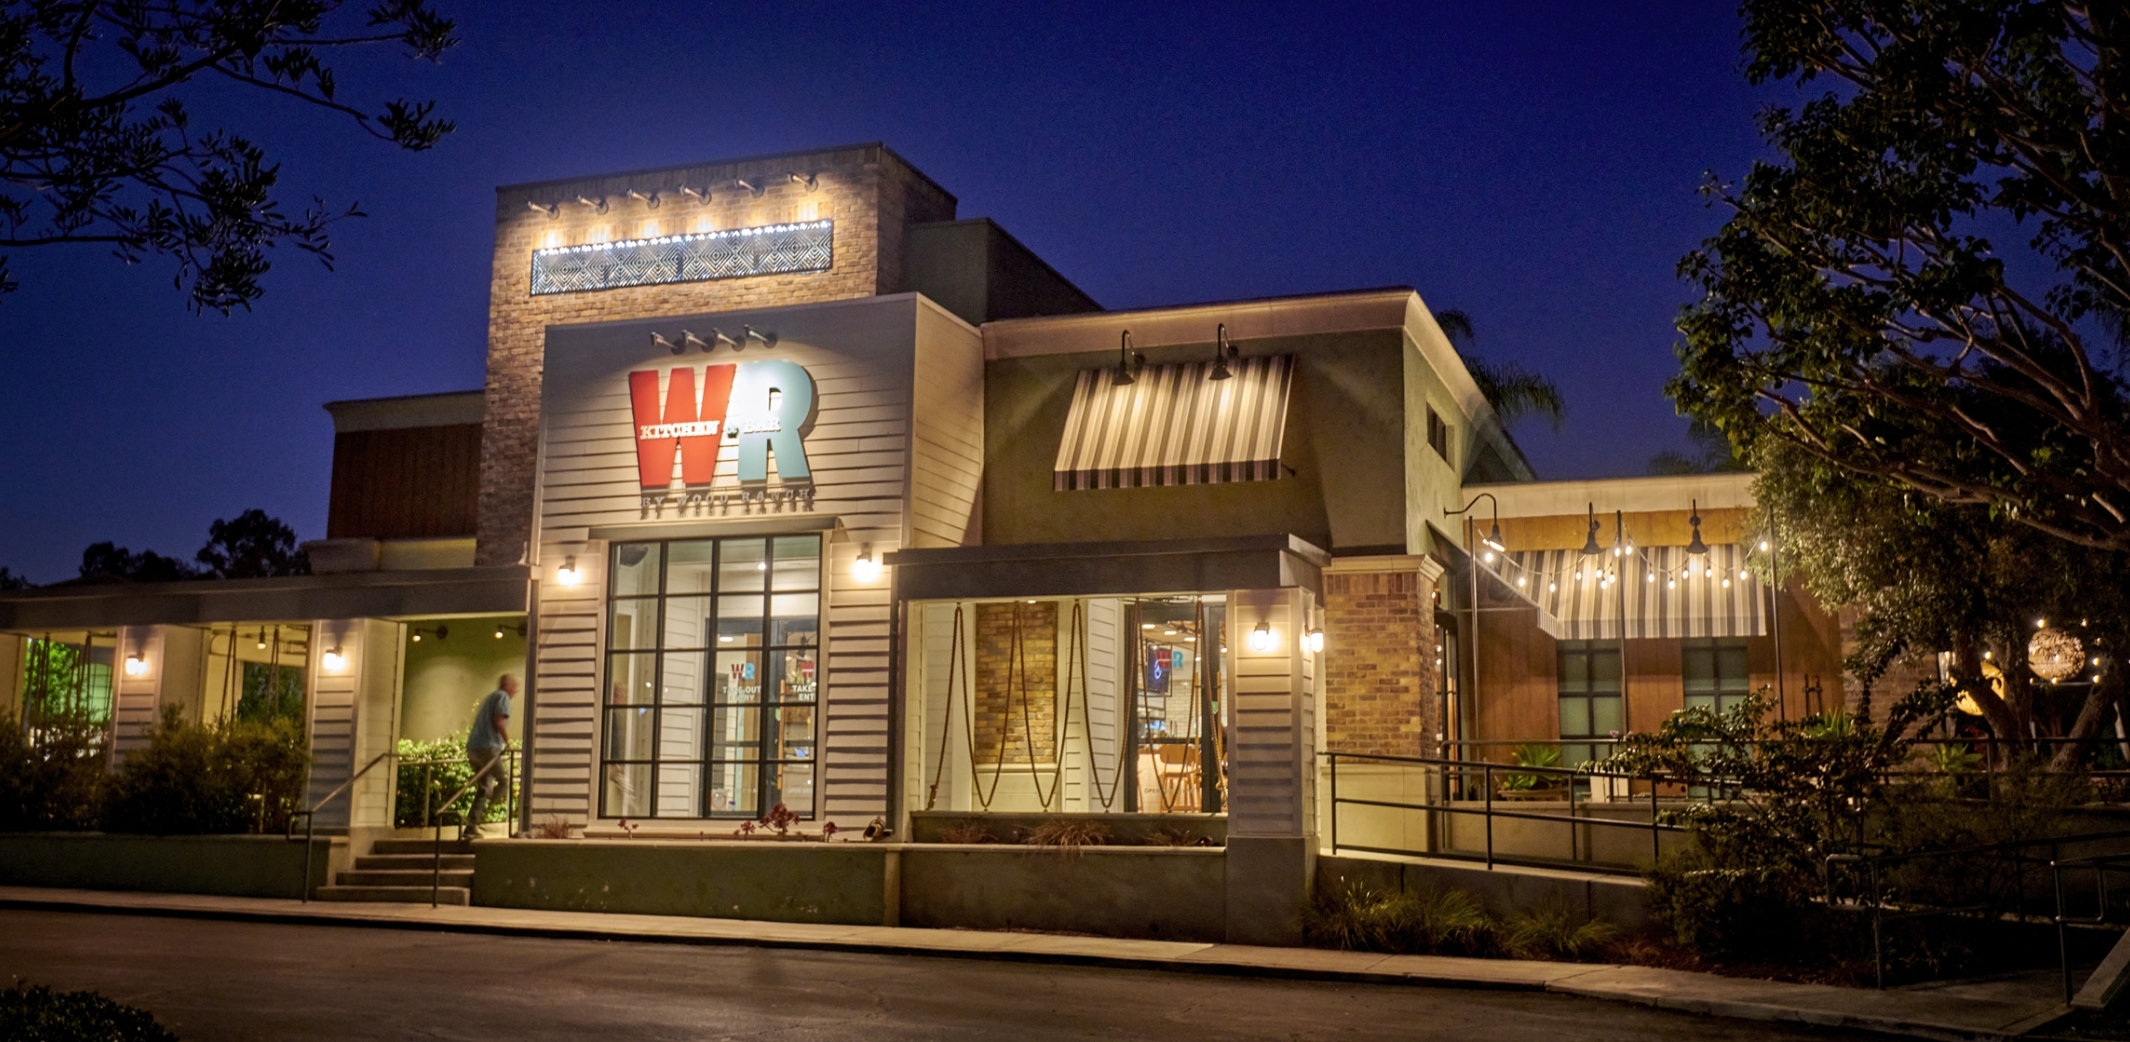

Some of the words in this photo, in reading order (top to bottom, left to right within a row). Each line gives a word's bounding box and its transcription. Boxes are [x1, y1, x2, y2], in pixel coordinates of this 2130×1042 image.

[629, 360, 812, 486] WR
[640, 420, 720, 440] KITCHEN
[642, 495, 665, 508] BY
[676, 493, 729, 507] WOOD
[741, 488, 810, 503] RANCH
[731, 662, 756, 680] WR
